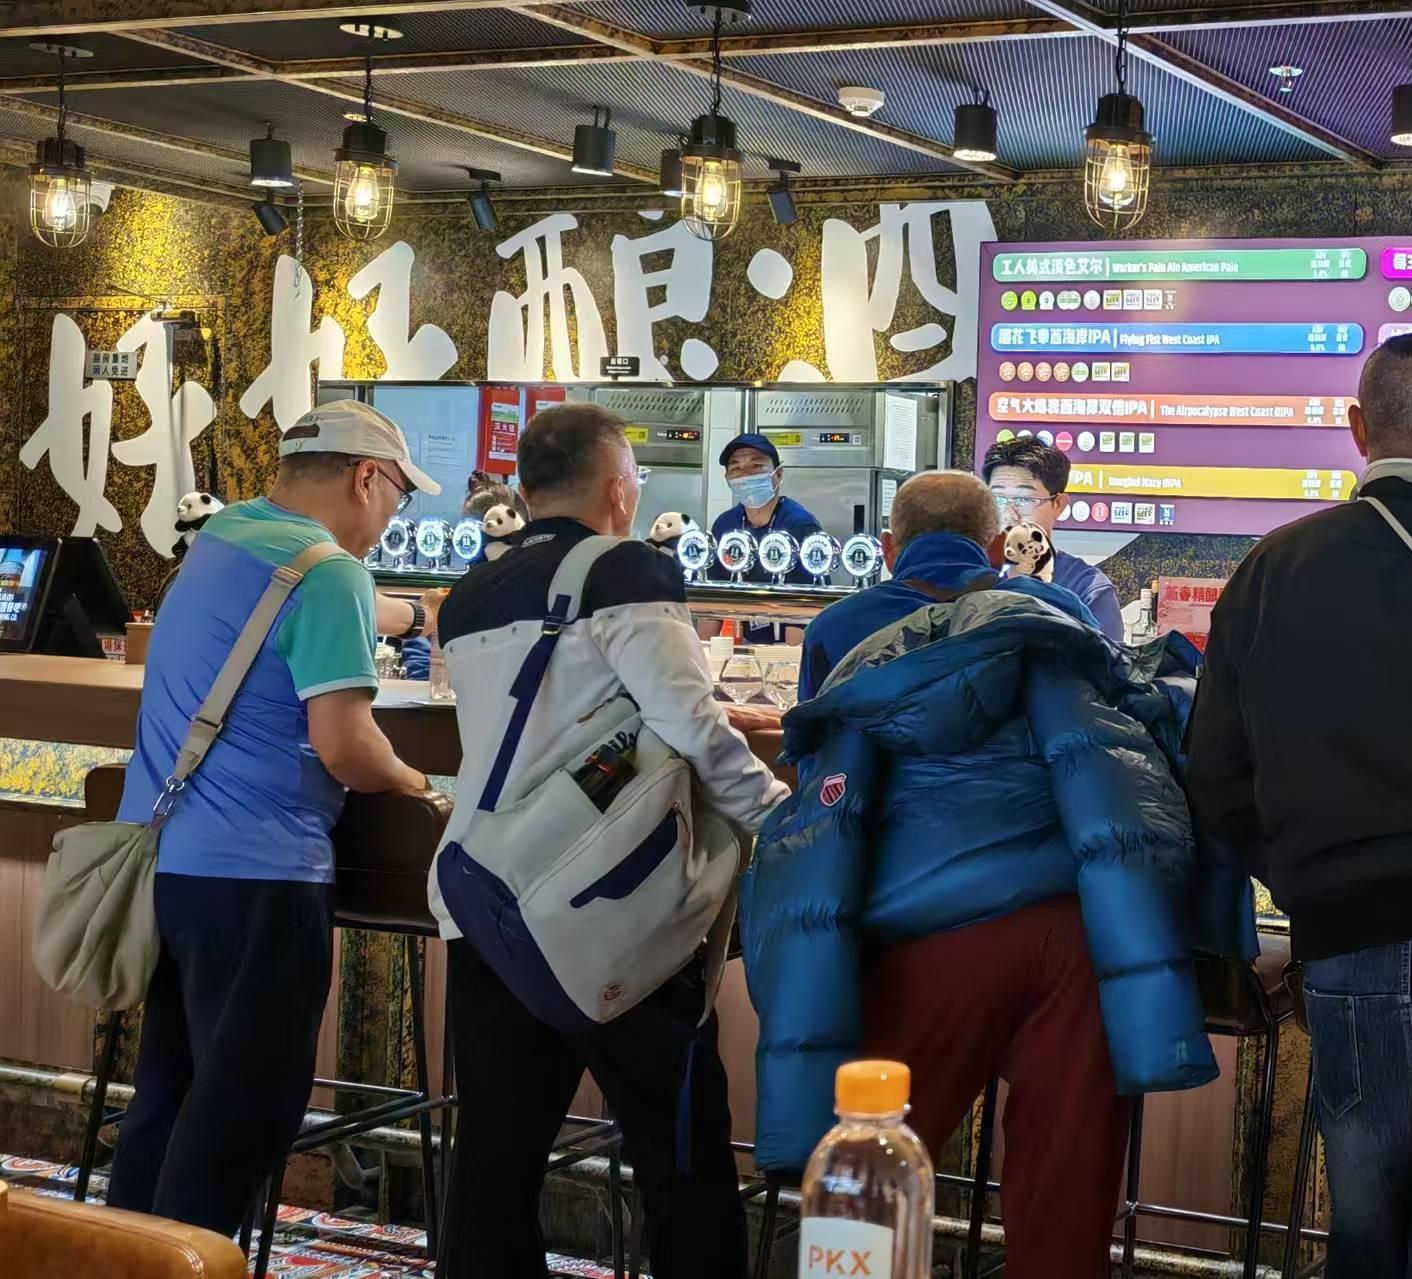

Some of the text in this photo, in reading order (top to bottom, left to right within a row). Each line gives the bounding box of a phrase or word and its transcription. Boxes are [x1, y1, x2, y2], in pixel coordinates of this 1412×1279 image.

[1120, 334, 1144, 346] Flying
[1145, 334, 1161, 345] Fist
[1183, 334, 1205, 345] Coast
[1160, 405, 1174, 416] The
[808, 1244, 871, 1276] PKX
